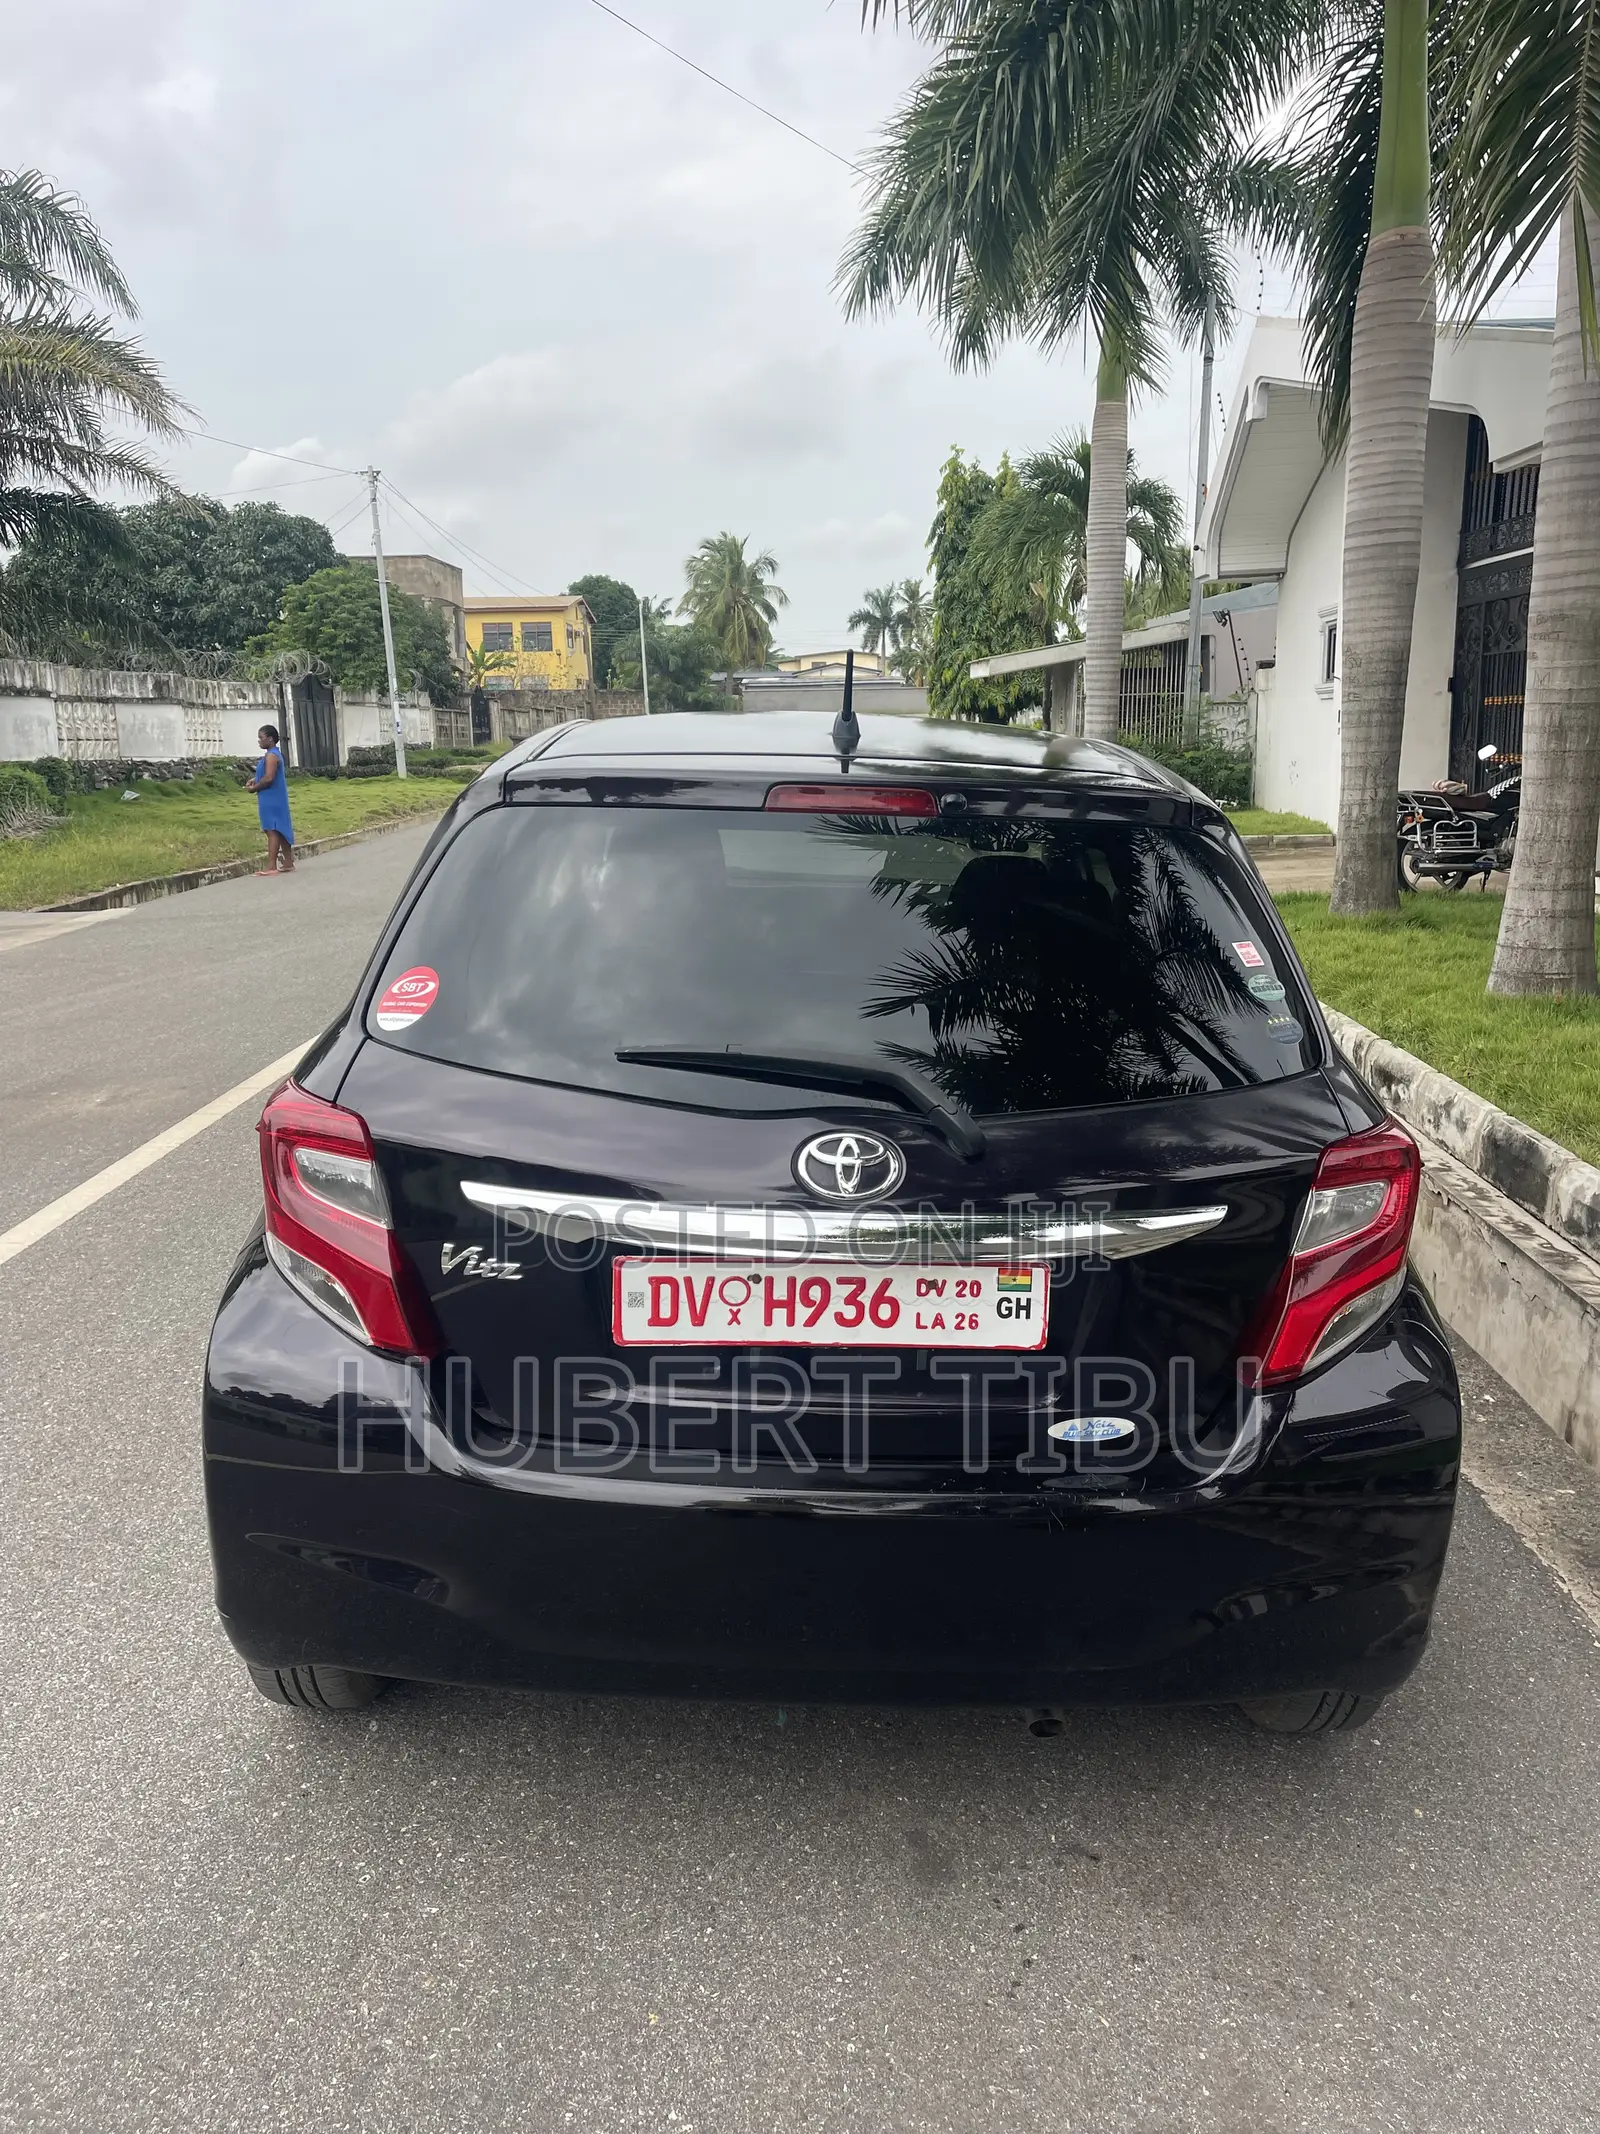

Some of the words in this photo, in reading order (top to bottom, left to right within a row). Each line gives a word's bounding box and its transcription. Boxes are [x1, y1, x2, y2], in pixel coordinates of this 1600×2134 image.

[401, 982, 425, 993] SBT
[441, 1242, 523, 1280] Vitz
[915, 1277, 948, 1298] DV
[954, 1278, 982, 1298] 20
[647, 1275, 716, 1327] DV
[763, 1275, 901, 1329] H936
[996, 1296, 1032, 1320] GH
[915, 1311, 946, 1330] LA
[953, 1312, 980, 1330] 26
